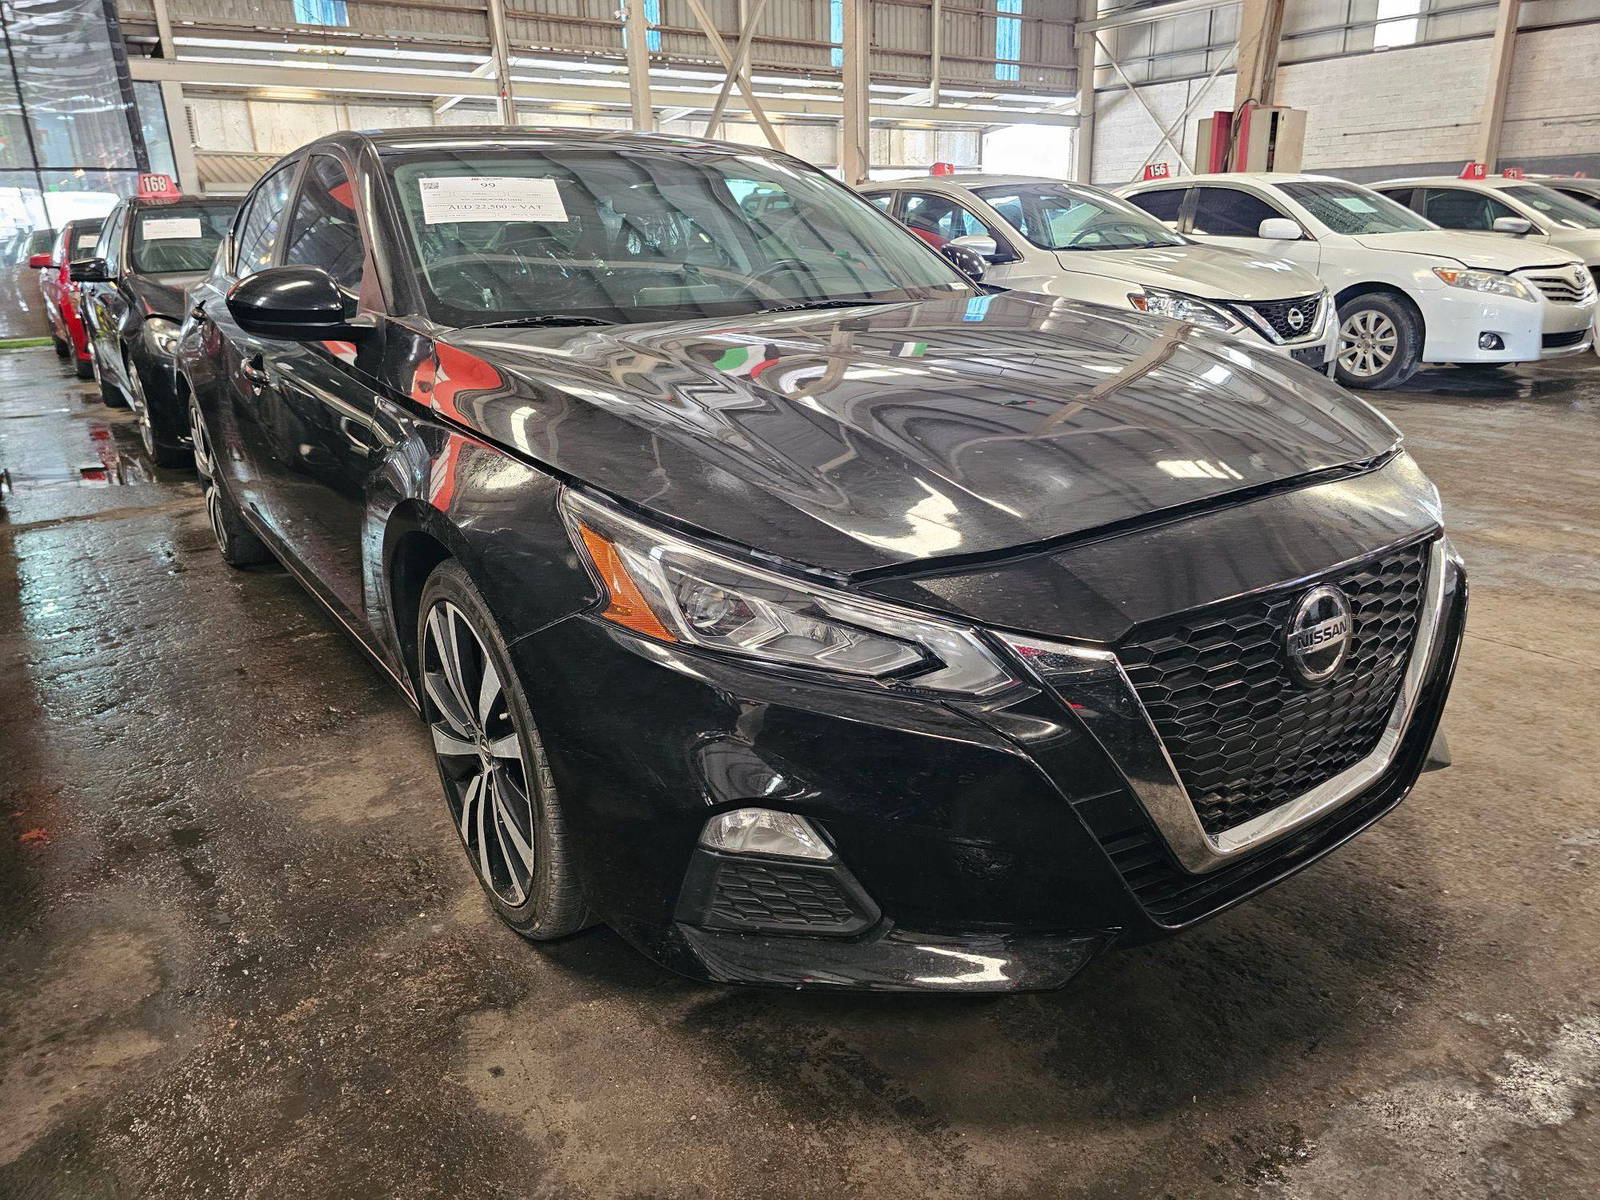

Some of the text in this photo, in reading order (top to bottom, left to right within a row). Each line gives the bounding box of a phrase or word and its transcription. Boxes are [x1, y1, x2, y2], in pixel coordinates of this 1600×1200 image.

[1150, 164, 1166, 177] 156
[143, 176, 167, 192] 168
[1297, 621, 1347, 649] NISSAN
